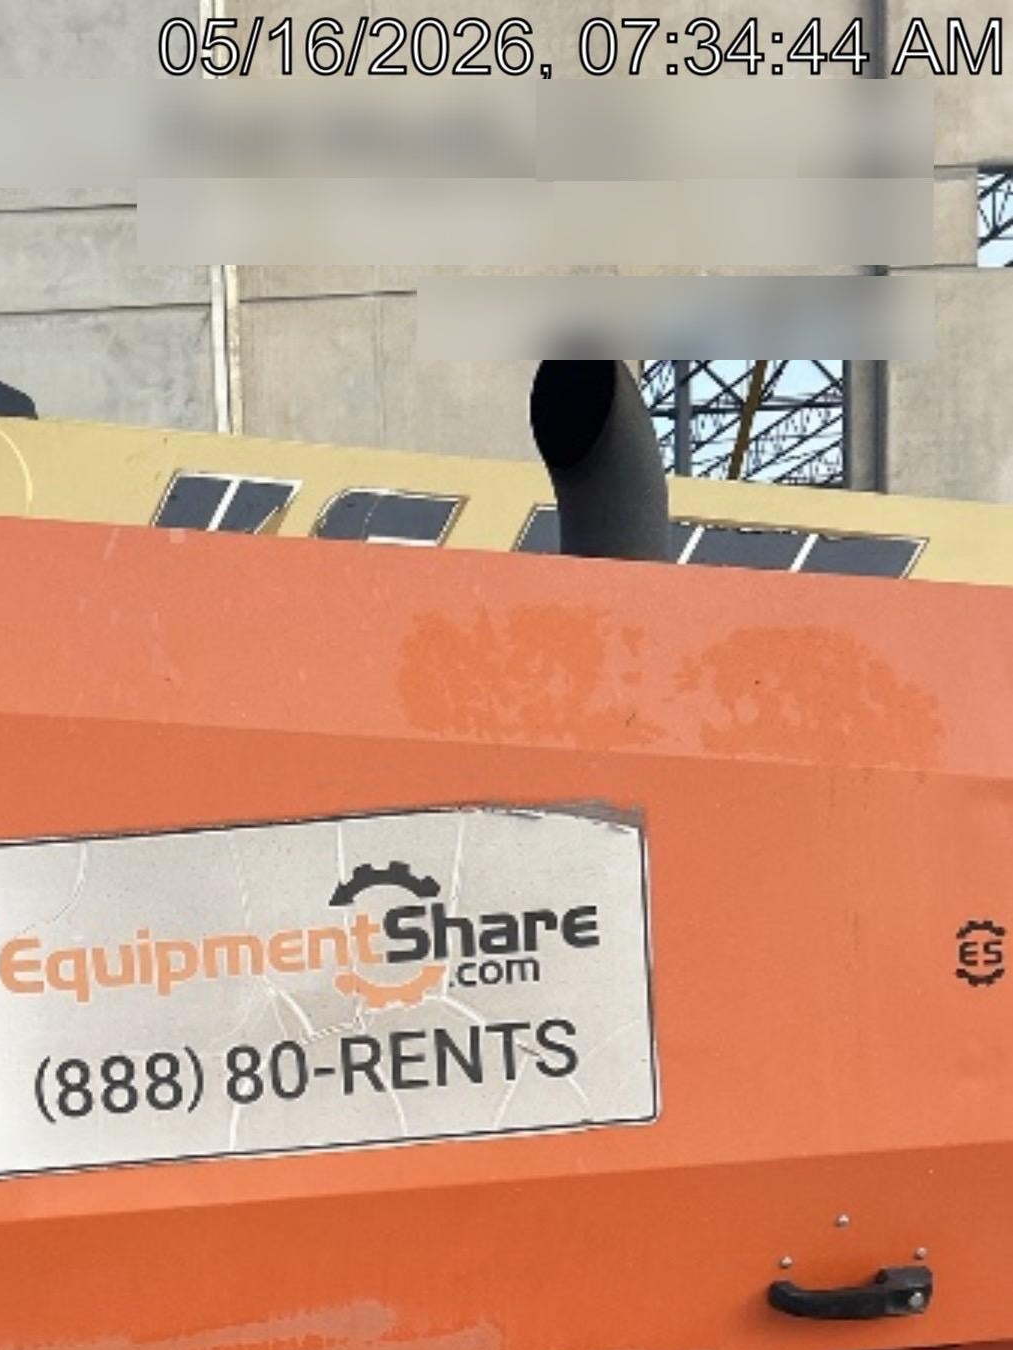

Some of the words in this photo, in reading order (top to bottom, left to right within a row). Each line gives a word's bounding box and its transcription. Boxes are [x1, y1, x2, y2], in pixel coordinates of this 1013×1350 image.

[959, 940, 1003, 966] ES
[449, 955, 541, 988] .com
[33, 1047, 204, 1124] (888)
[224, 1018, 580, 1104] 80-RENTS
